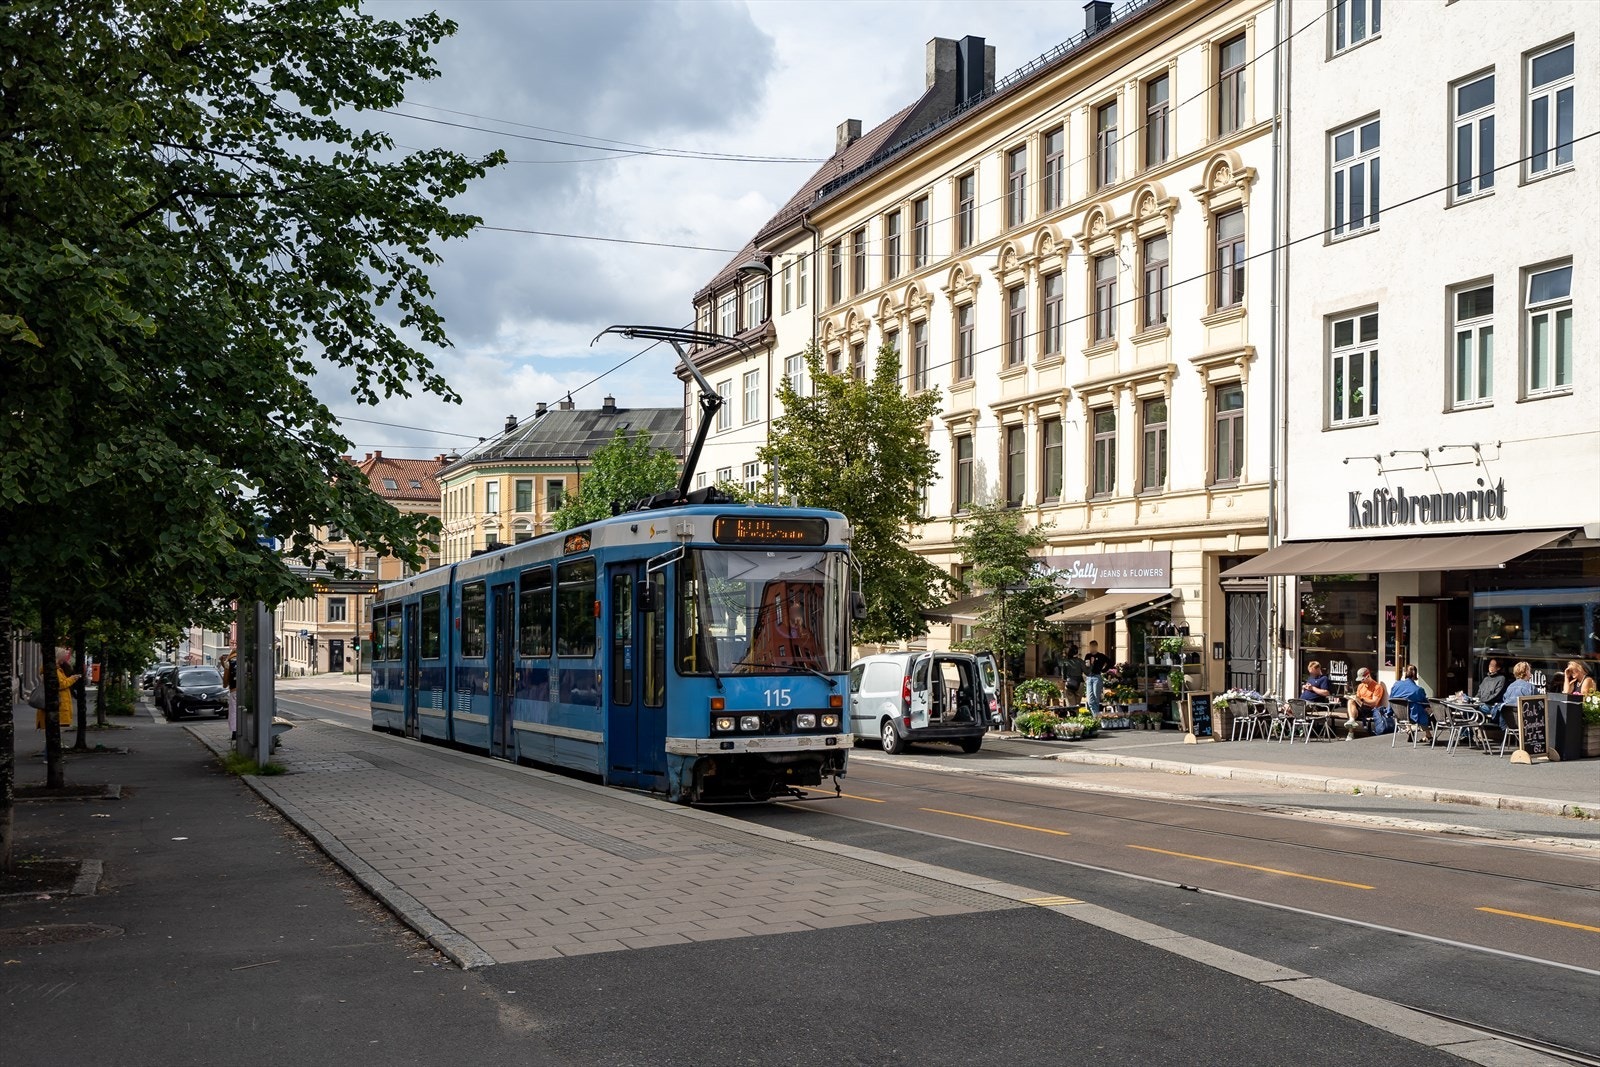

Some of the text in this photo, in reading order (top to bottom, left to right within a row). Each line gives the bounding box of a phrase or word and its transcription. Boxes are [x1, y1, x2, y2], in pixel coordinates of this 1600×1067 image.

[1348, 477, 1506, 529] Kaffebrenneriet
[1072, 560, 1099, 585] Sally
[1100, 569, 1121, 578] JEANS
[1122, 569, 1128, 578] &
[1130, 568, 1164, 577] FLOWERS
[1330, 660, 1348, 674] Kaffe
[1529, 669, 1546, 686] affe
[763, 688, 792, 707] 115
